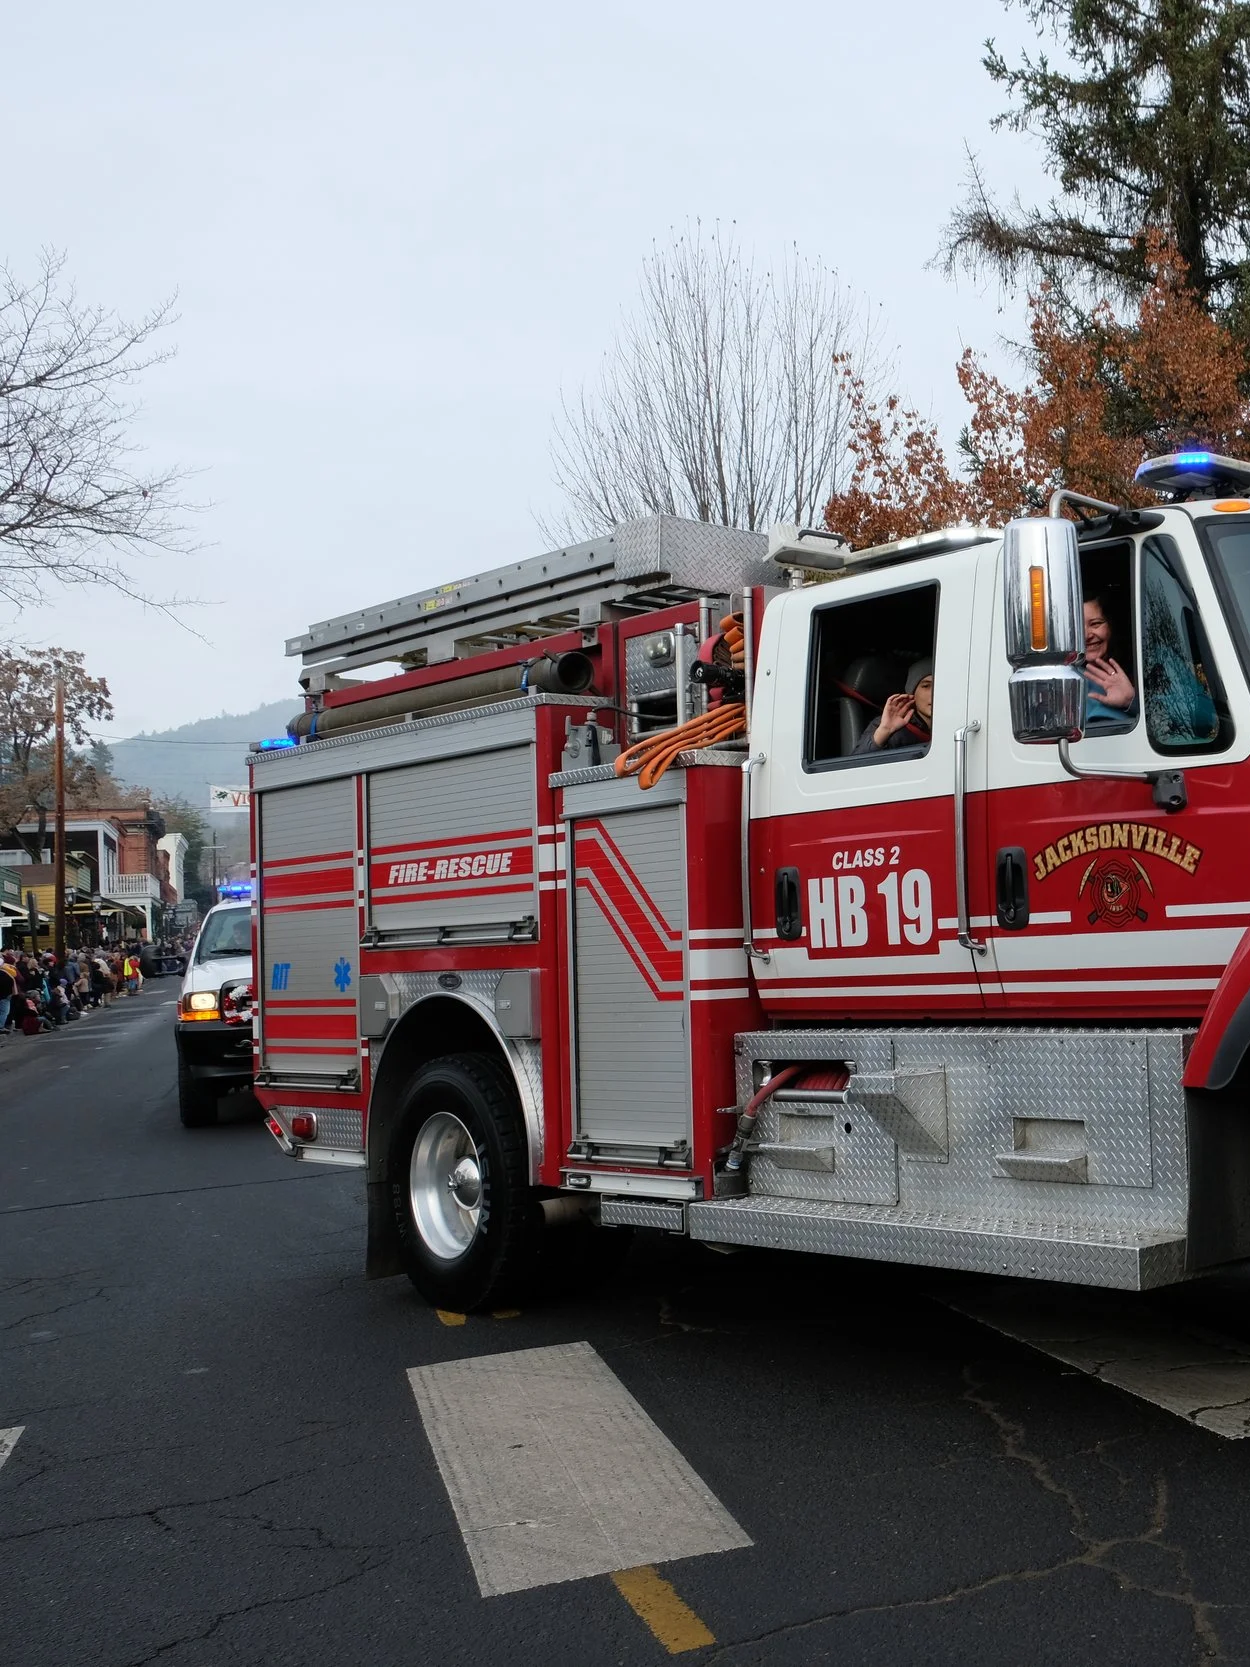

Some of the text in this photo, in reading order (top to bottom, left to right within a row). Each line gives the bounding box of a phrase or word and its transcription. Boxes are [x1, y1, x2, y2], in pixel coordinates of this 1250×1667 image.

[832, 845, 900, 870] CLASS 2
[1032, 822, 1202, 881] JACKSONVILLE
[388, 852, 513, 885] FIRE-RESCUE
[807, 868, 933, 949] HB 19
[271, 963, 291, 991] RIT
